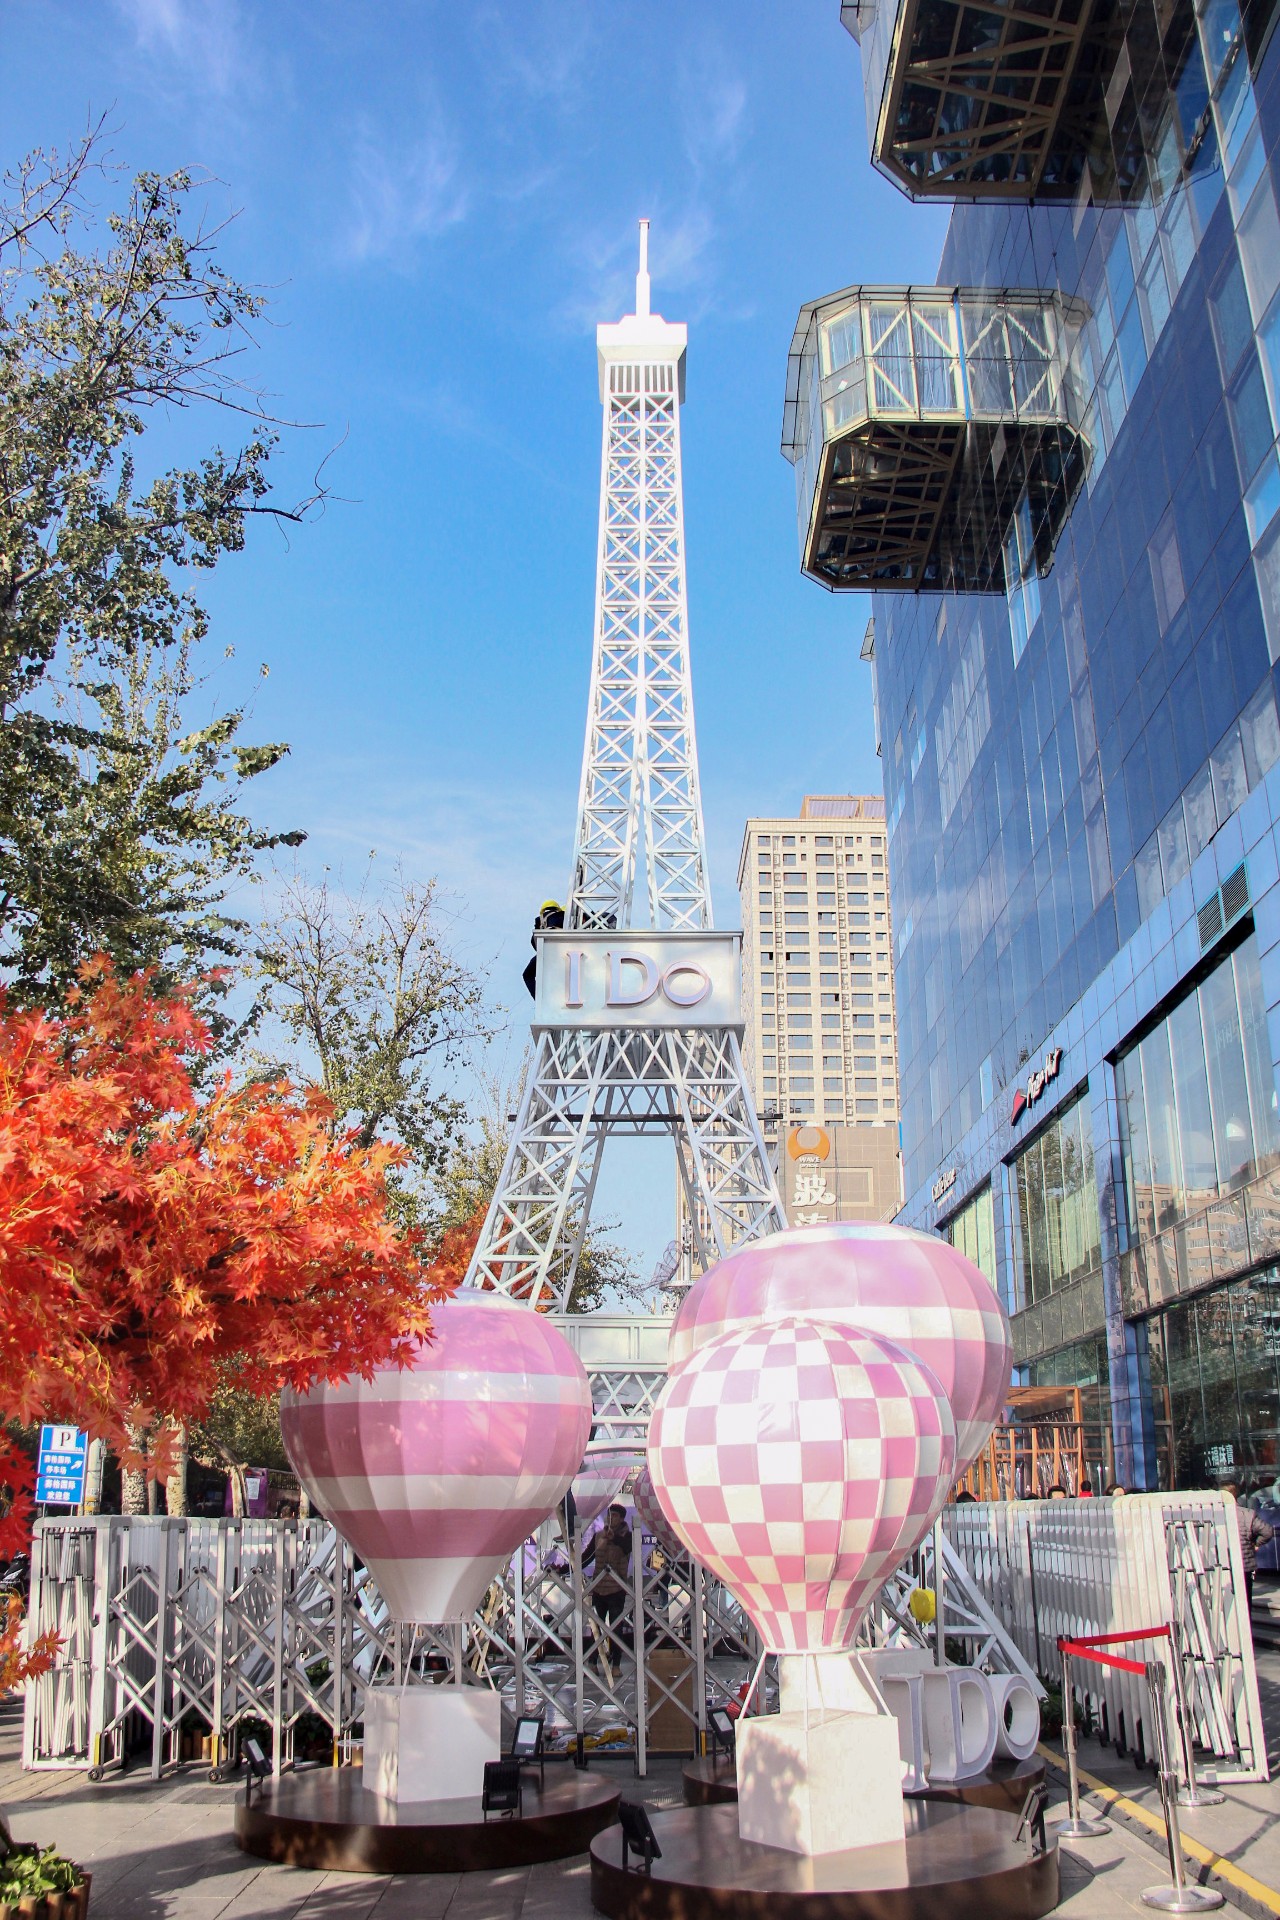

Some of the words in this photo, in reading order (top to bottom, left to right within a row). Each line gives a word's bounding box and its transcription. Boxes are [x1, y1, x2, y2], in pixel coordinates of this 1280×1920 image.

[565, 951, 584, 1007] I
[606, 951, 710, 1006] Do
[60, 1431, 71, 1447] P
